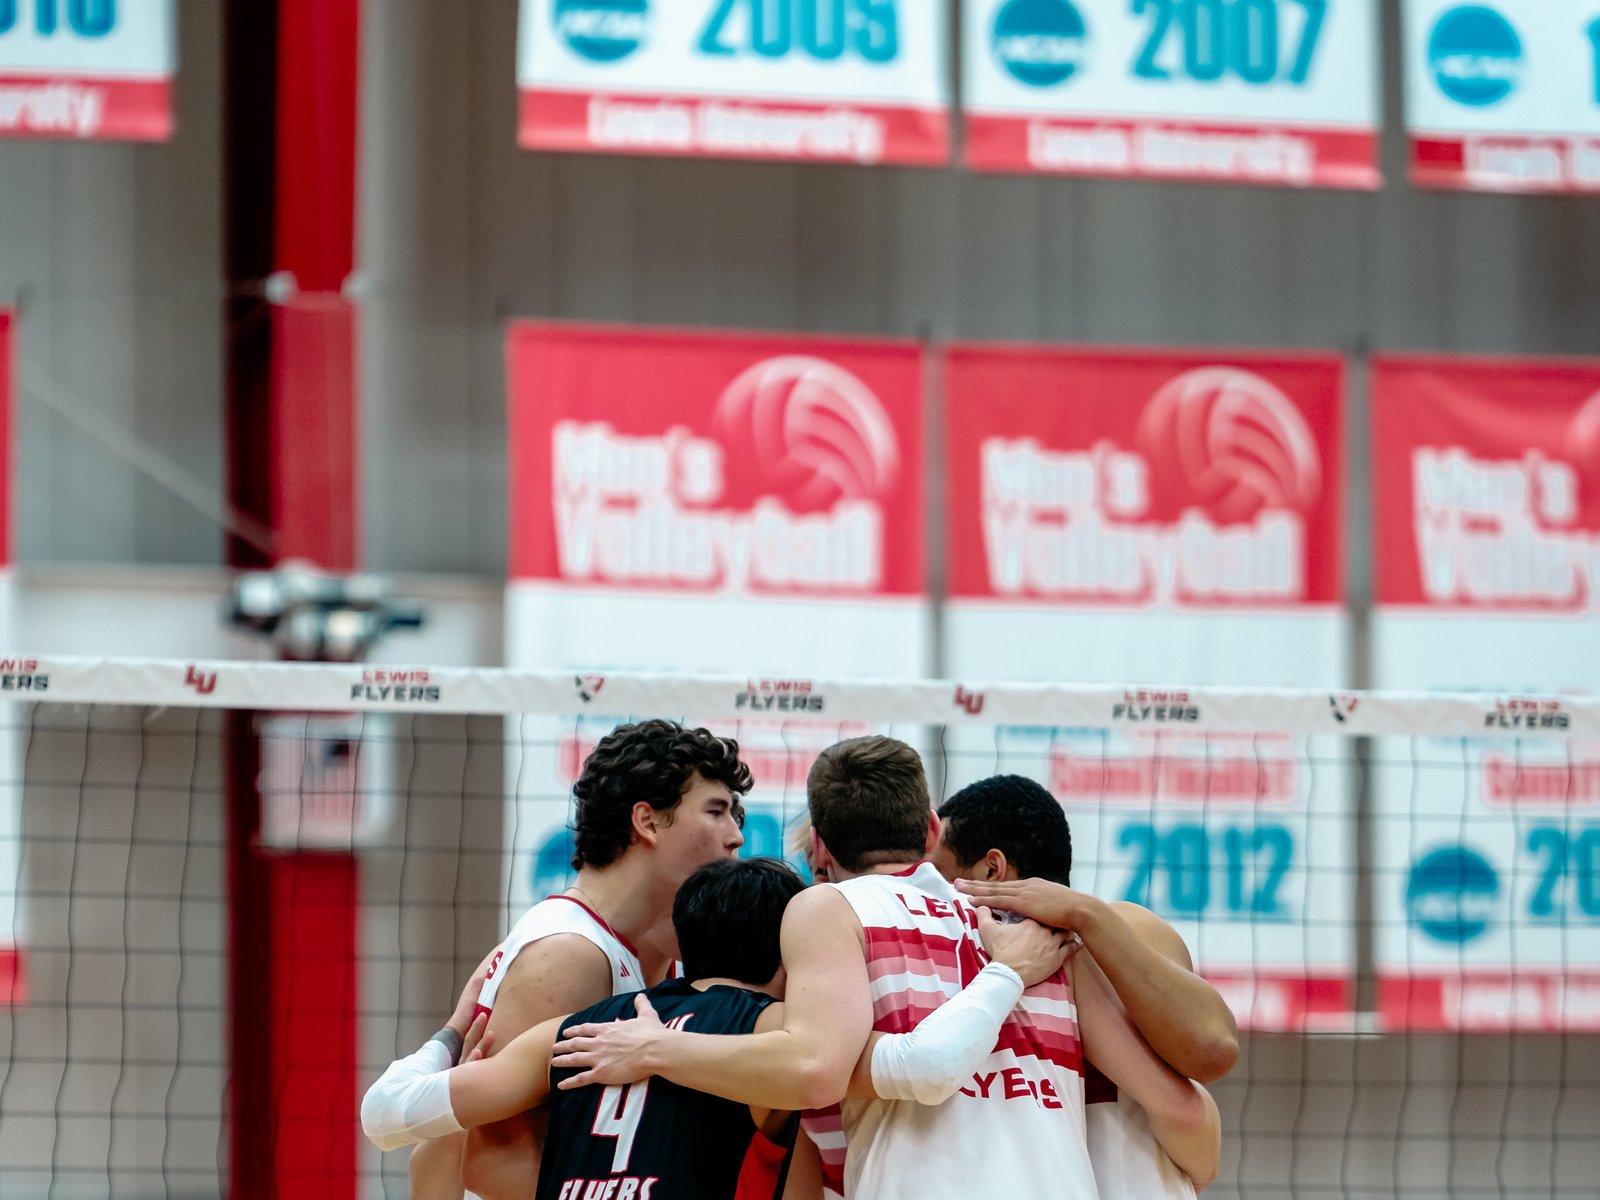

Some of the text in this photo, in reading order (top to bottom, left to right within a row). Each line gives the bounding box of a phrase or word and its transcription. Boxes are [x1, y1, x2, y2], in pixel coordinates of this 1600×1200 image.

[1131, 0, 1328, 84] 2007
[362, 669, 430, 683] LEWIS
[351, 684, 440, 702] FLYERS
[746, 679, 813, 695] LEWIS
[735, 693, 824, 712] FLYERS
[1123, 690, 1190, 704] LEWIS
[1112, 704, 1199, 722] FLYERS
[1485, 712, 1570, 731] FLYERS
[1119, 820, 1293, 913] 2012
[592, 1077, 649, 1174] 4
